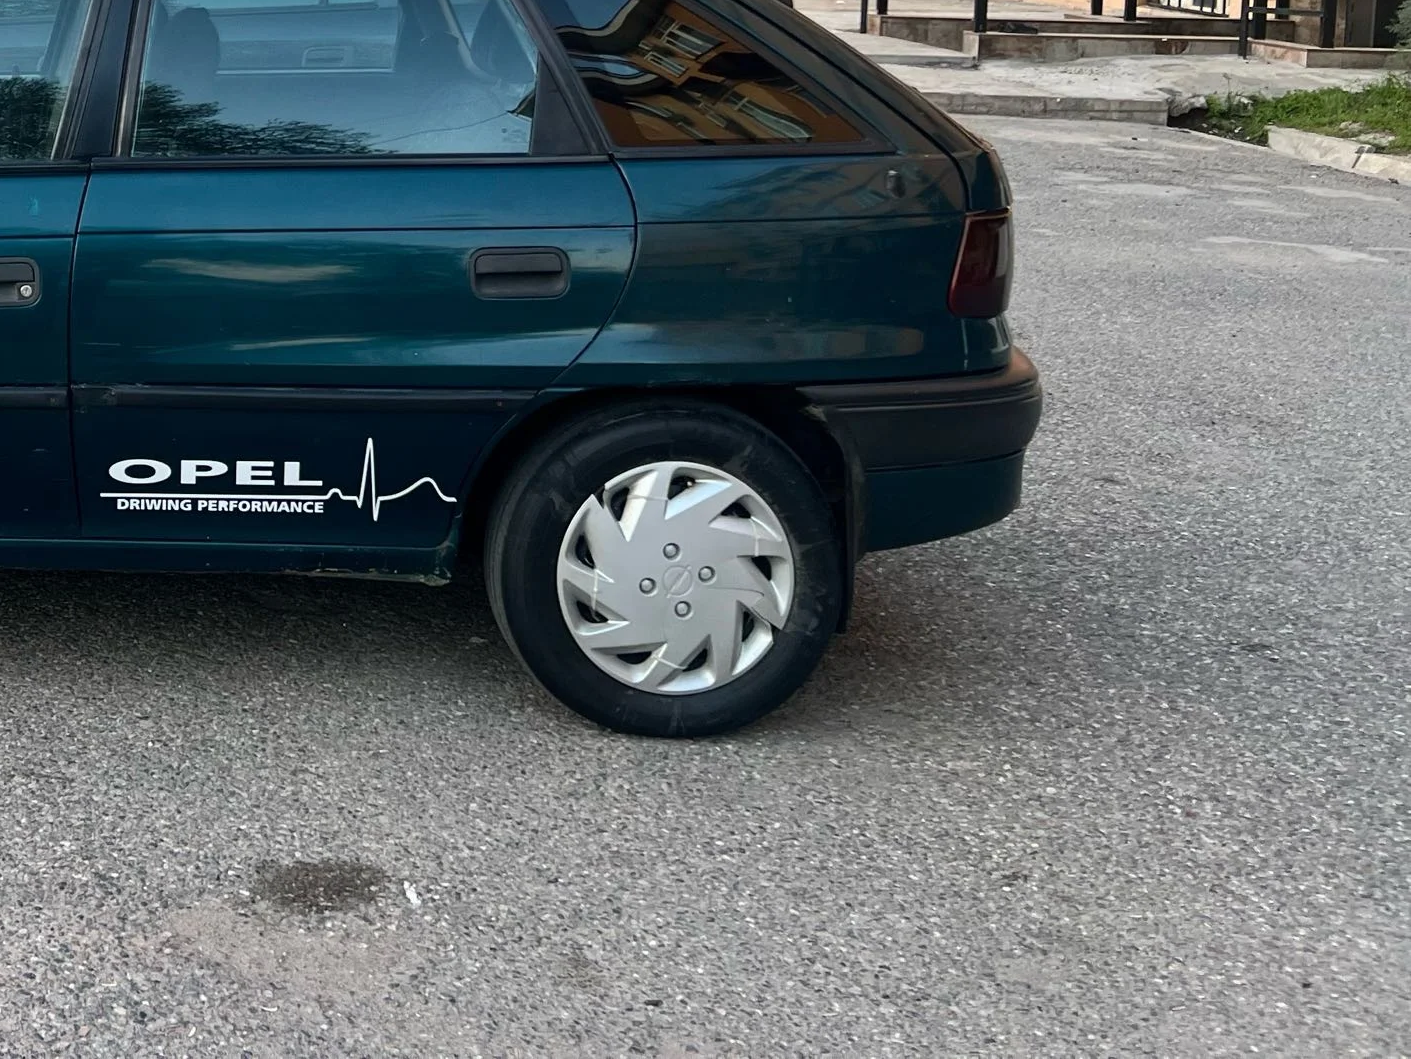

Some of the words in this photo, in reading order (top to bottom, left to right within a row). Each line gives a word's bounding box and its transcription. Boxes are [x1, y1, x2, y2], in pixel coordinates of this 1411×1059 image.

[108, 458, 323, 486] OPEL
[116, 498, 192, 512] DRIWING
[197, 499, 324, 513] PERFORMANCE
